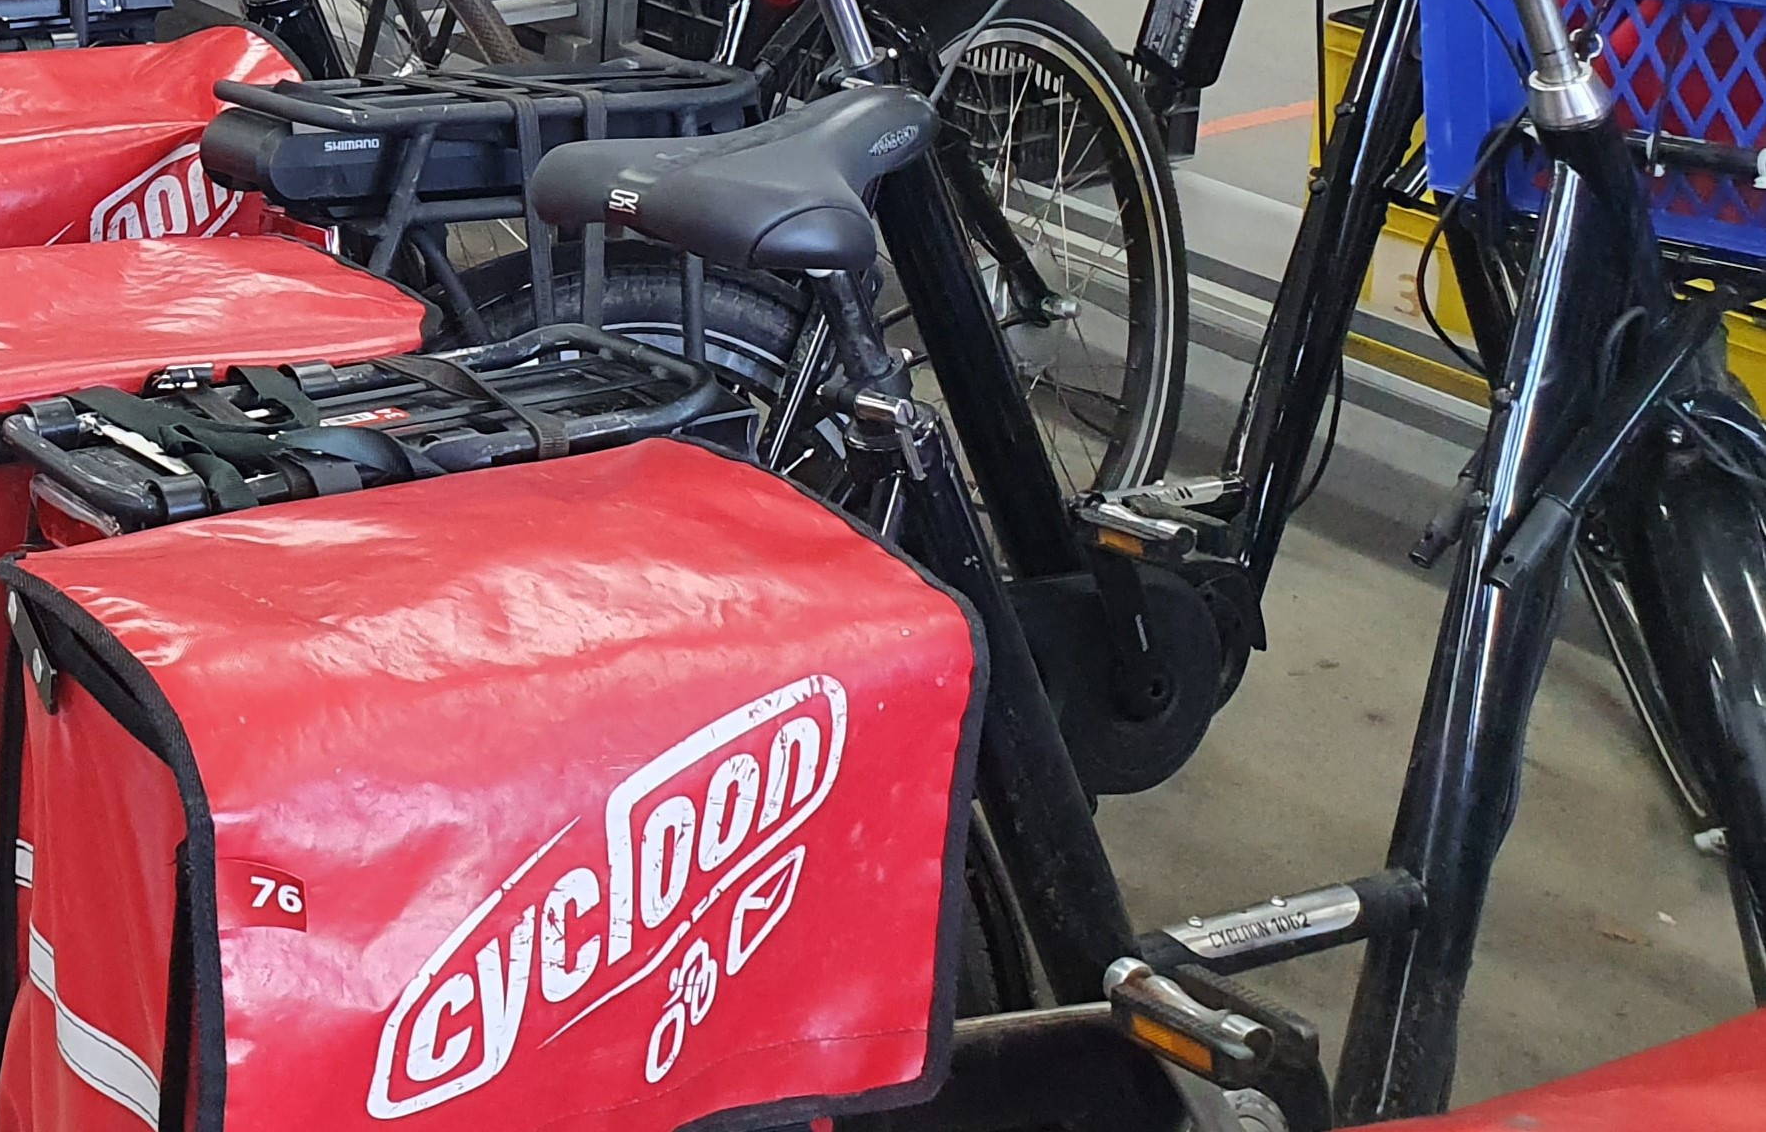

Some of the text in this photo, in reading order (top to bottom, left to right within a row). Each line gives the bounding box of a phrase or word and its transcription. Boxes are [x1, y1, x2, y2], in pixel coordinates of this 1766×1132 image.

[323, 137, 380, 152] SHIMANO
[250, 875, 303, 914] 76
[404, 714, 824, 1082] cycloon
[1208, 919, 1272, 949] CYCLOON
